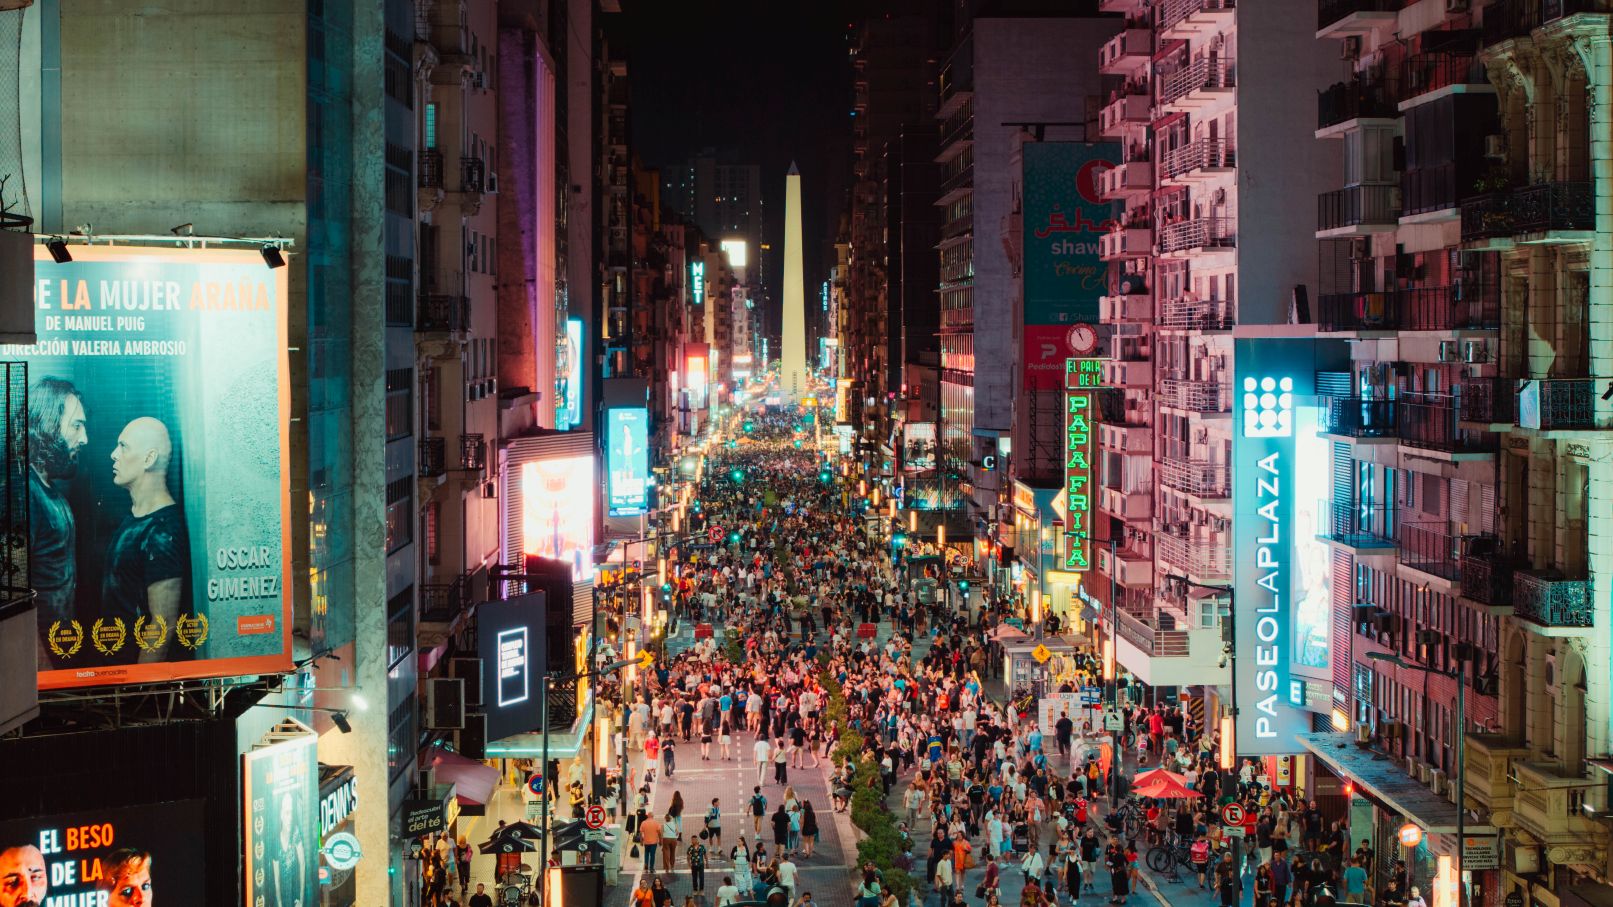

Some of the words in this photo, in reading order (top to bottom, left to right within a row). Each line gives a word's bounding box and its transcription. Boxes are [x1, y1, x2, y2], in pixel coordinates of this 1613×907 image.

[1051, 239, 1100, 255] shaw
[35, 279, 51, 310] E
[60, 279, 91, 310] LA
[100, 280, 181, 311] MUJER
[189, 275, 270, 312] ARAÑA
[692, 262, 704, 304] MET
[45, 316, 62, 331] DE
[64, 316, 113, 331] MANUEL
[117, 316, 145, 331] PUIG
[2, 337, 68, 356] DIRECCIÓN
[72, 340, 121, 356] VALERIA
[124, 340, 186, 356] AMBROSIO
[1068, 361, 1078, 373] EL
[1067, 396, 1089, 469] PAPA
[1066, 475, 1089, 566] FRITA
[217, 546, 270, 571] OSCAR
[208, 575, 278, 602] GIMENEZ
[409, 820, 426, 832] del
[428, 816, 441, 828] té
[40, 829, 62, 854] EL
[66, 823, 114, 851] BESO
[51, 861, 75, 886] DE
[81, 858, 104, 882] LA
